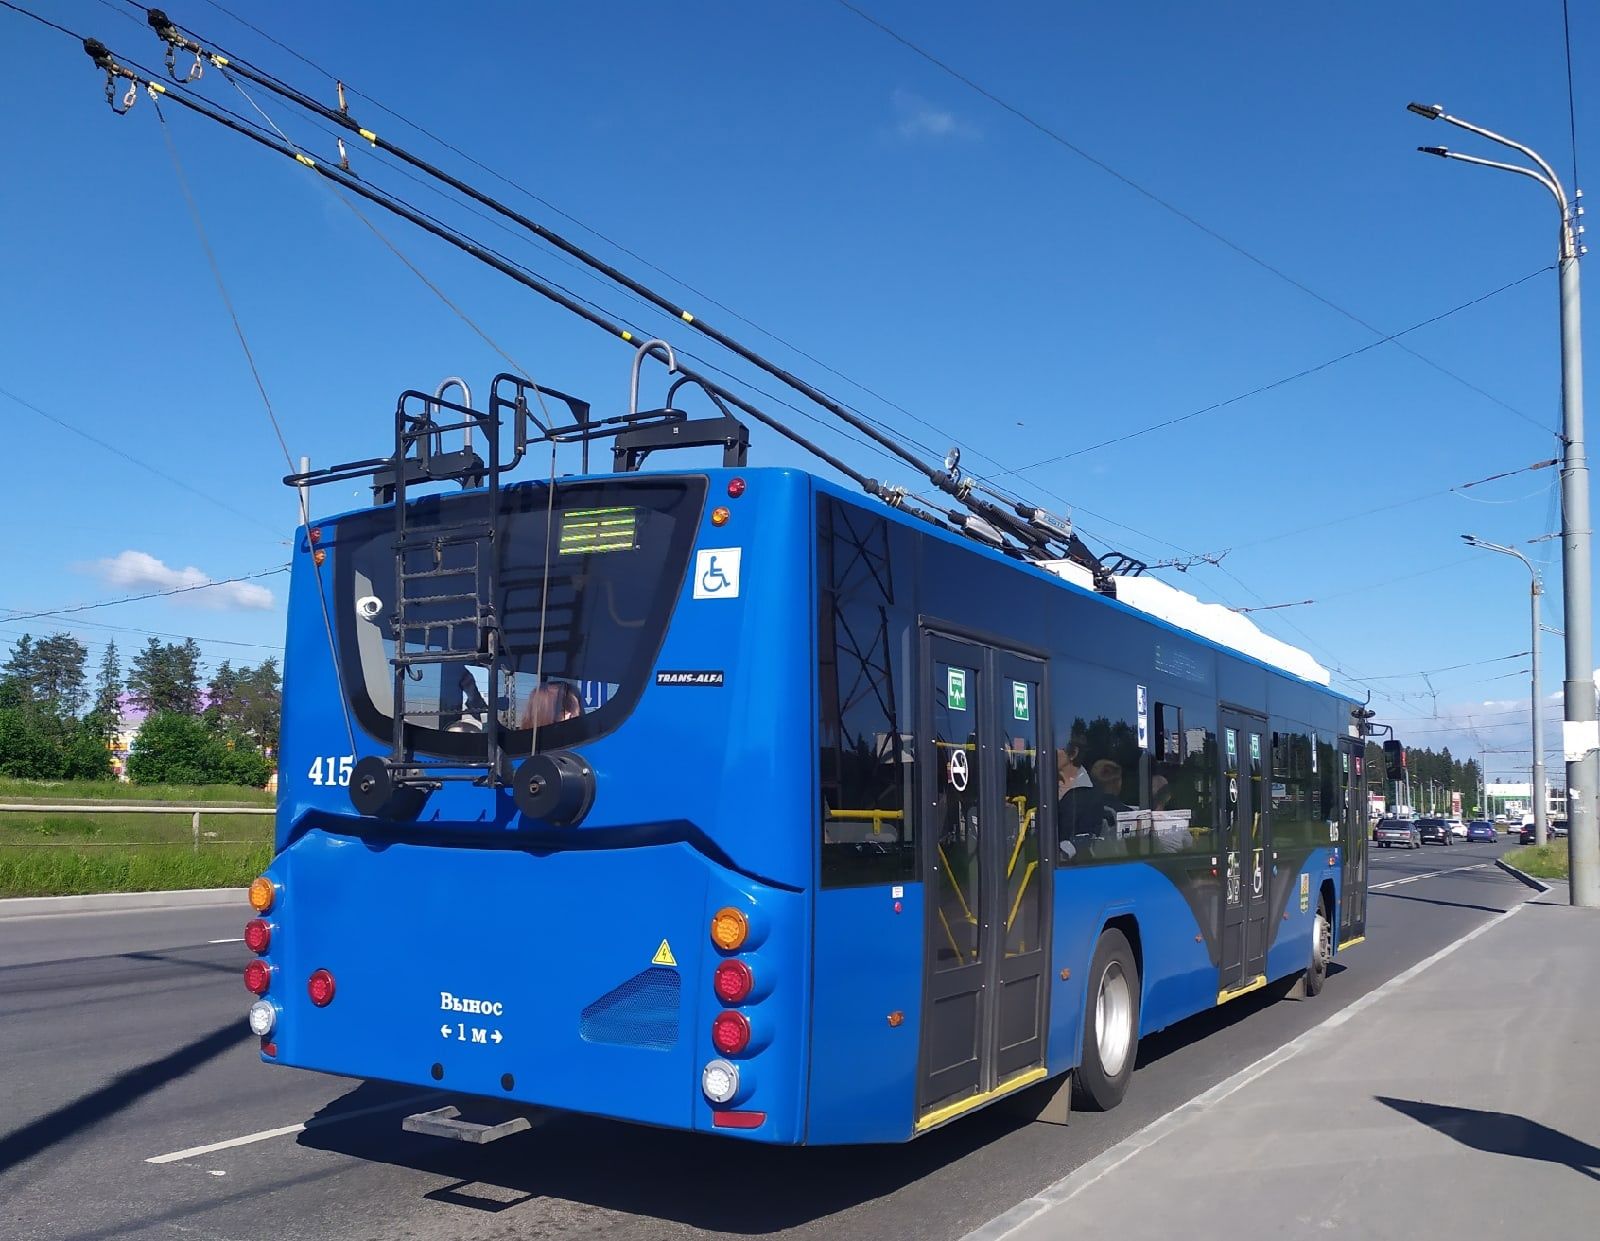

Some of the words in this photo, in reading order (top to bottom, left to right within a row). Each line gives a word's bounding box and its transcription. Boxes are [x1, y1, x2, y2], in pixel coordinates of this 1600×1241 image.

[657, 673, 723, 683] TRANS-ALFA
[308, 755, 354, 787] 415
[440, 991, 503, 1016] Вынос
[458, 1023, 466, 1041] 1
[471, 1028, 487, 1044] м
